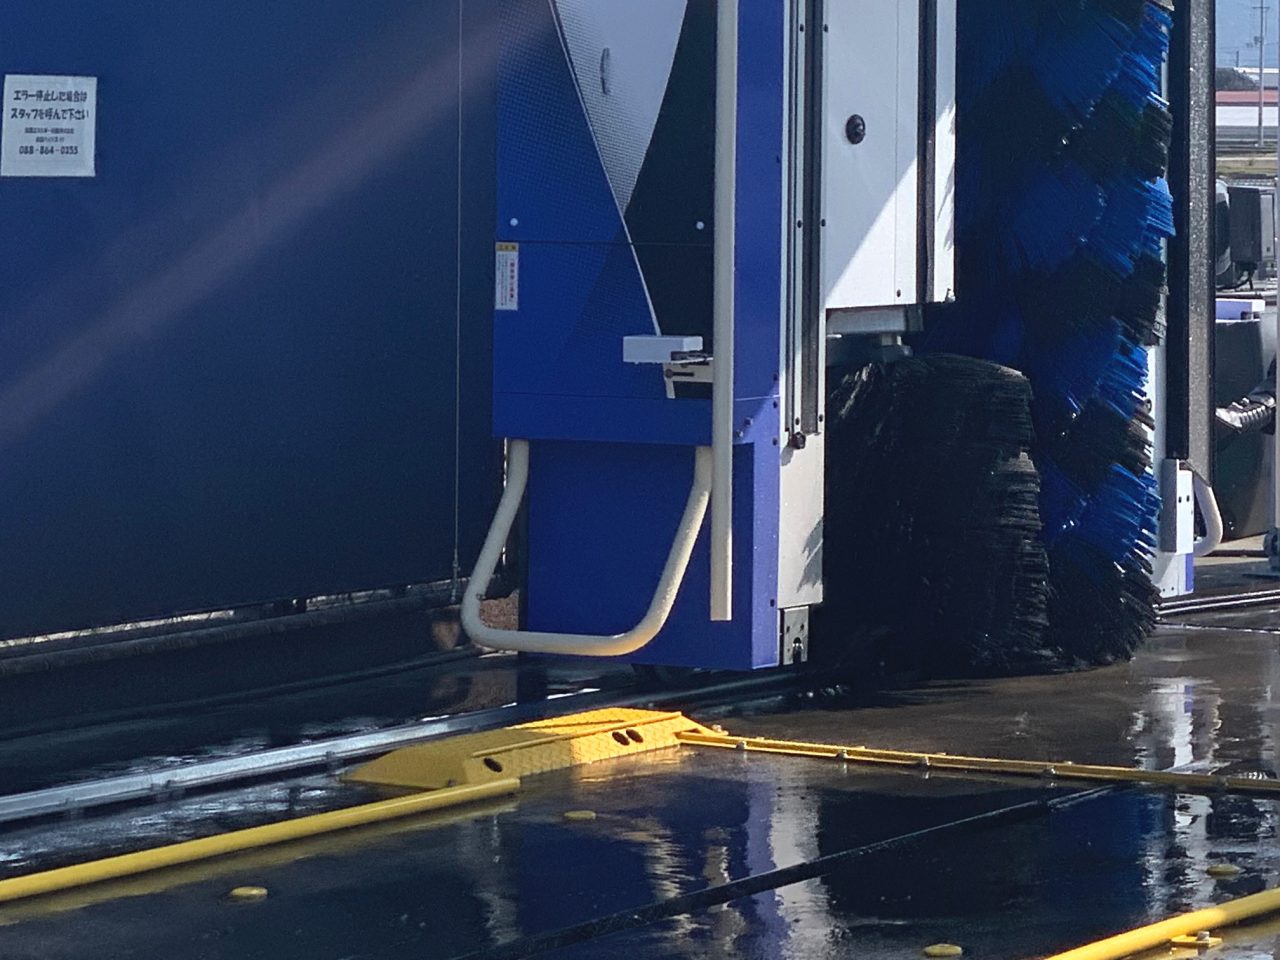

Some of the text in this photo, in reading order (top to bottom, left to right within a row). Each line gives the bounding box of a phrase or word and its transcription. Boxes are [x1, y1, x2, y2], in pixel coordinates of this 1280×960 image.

[11, 108, 89, 120] スタッフを呼んで下さい
